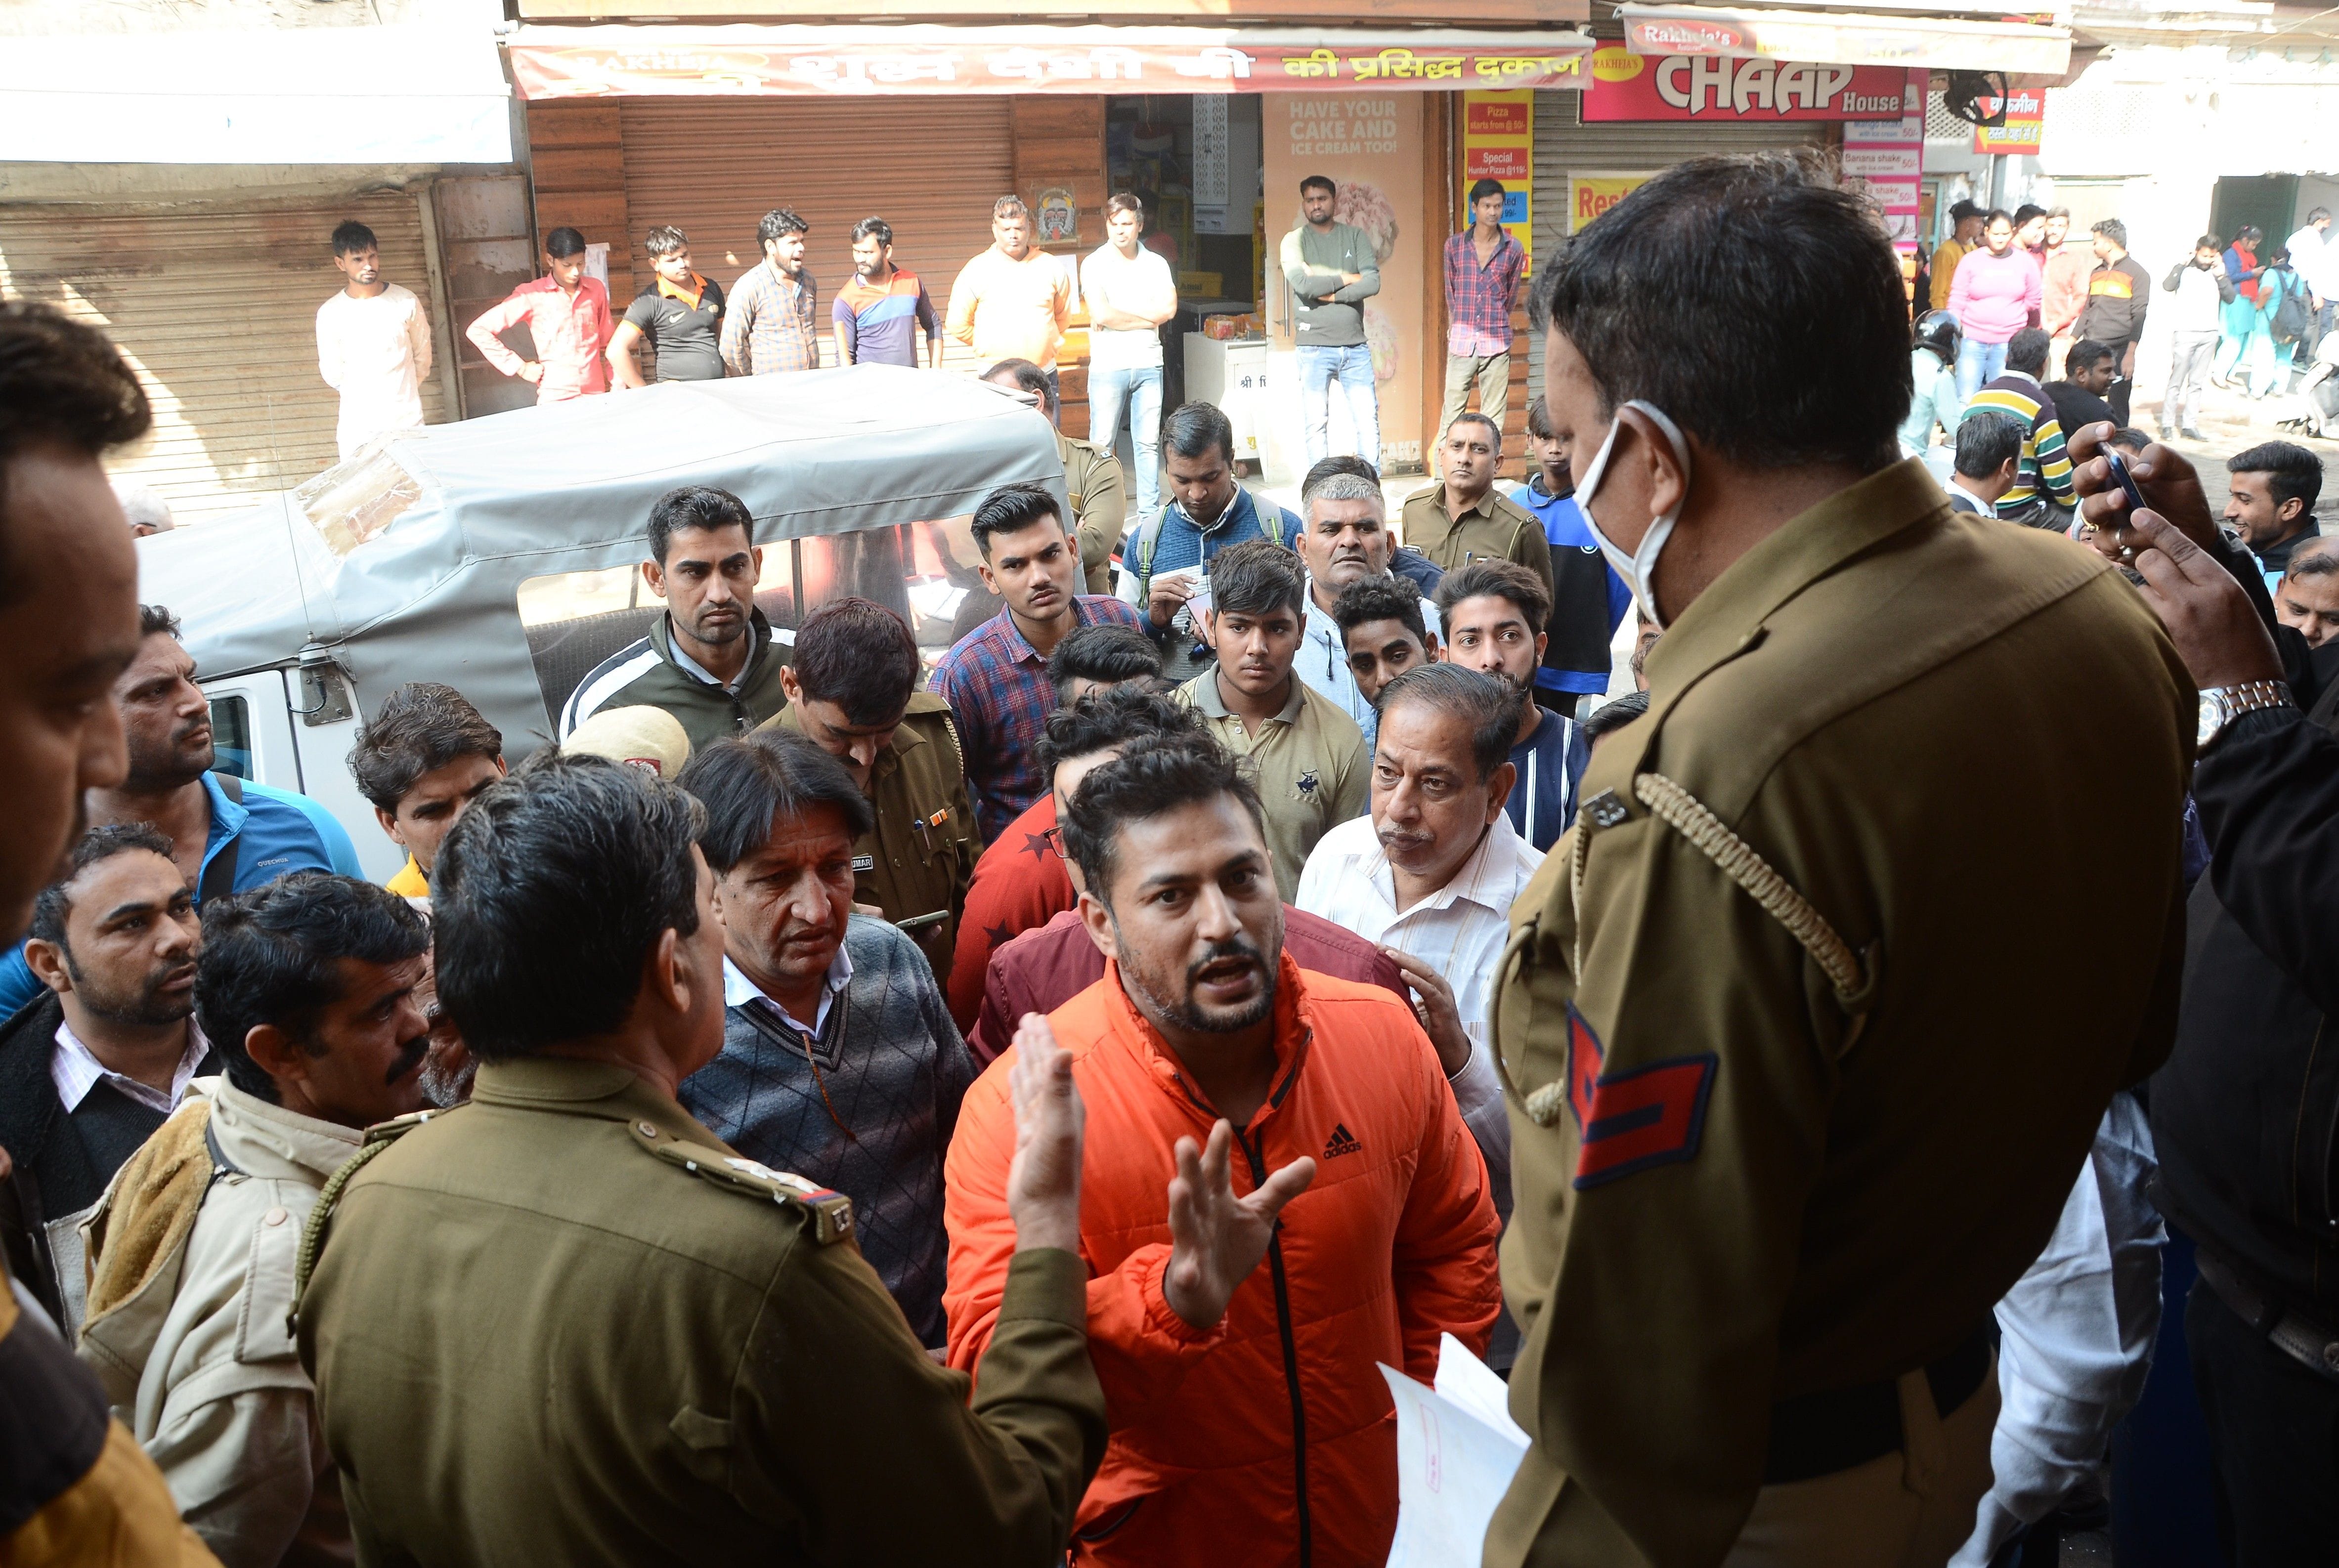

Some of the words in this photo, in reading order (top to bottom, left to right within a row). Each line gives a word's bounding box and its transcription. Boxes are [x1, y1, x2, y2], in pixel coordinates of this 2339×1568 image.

[1282, 49, 1340, 78] की
[1349, 49, 1466, 81] प्रसिद्ध
[1594, 59, 1638, 68] RAKHEJA'S
[1656, 55, 1854, 115] CHAAP
[1842, 91, 1900, 112] House
[1290, 100, 1339, 118] HAVE
[1345, 100, 1396, 117] YOUR
[1488, 106, 1509, 117] Pizza
[1290, 121, 1345, 139] CAKE
[1352, 120, 1396, 138] AND
[1291, 143, 1312, 155] ICE
[1315, 142, 1360, 154] CREAM
[1365, 140, 1397, 153] TOO!
[1483, 152, 1513, 165] Special
[1845, 153, 1875, 162] Banana
[1878, 154, 1901, 162] shake
[1241, 376, 1252, 388] श्री
[258, 857, 289, 867] QUECHUA
[1323, 1142, 1362, 1160] adidas
